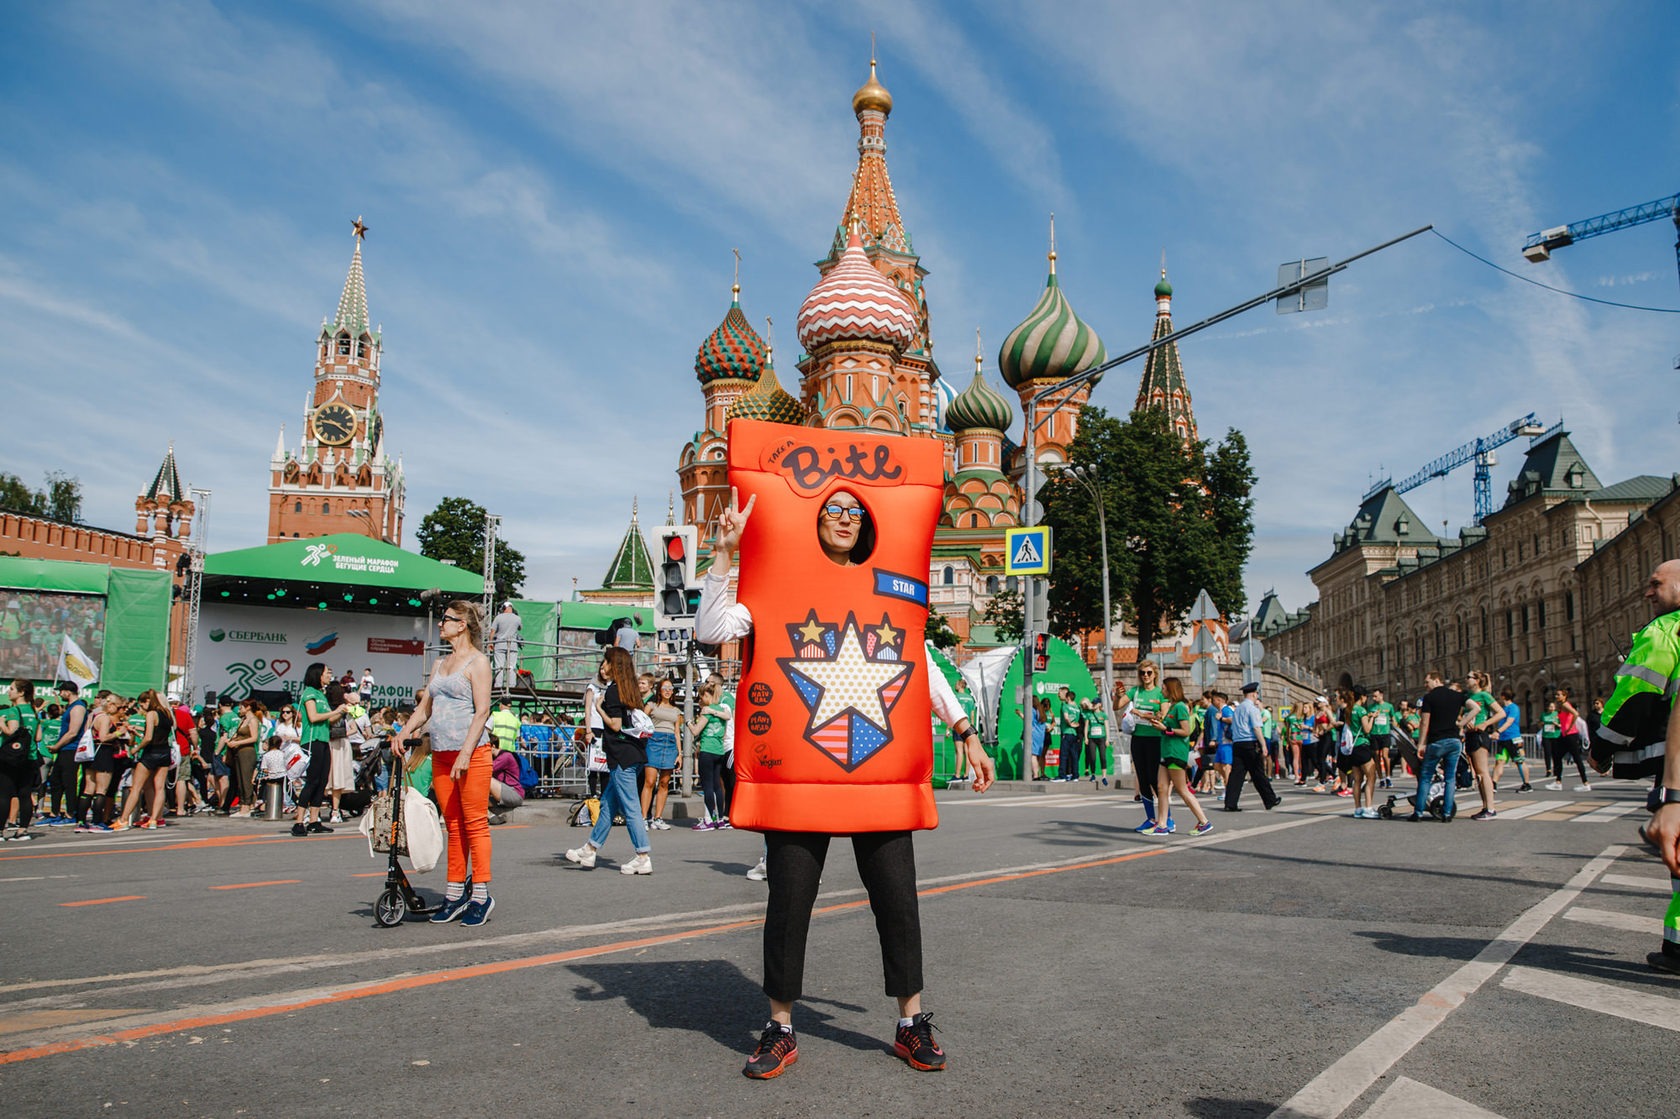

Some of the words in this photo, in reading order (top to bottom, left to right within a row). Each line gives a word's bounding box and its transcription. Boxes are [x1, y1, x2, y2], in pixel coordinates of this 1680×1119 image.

[767, 446, 786, 465] TAKE
[786, 440, 795, 448] A
[781, 444, 902, 490] Bite
[332, 554, 366, 565] ЗЕЛЕНЫЙ
[366, 557, 399, 568] МАРАФОН
[335, 562, 367, 572] БЕГУЩИЕ
[368, 564, 395, 574] СЕРДЦА
[892, 579, 915, 596] STAR
[228, 630, 287, 642] СБЕРБАНК
[352, 683, 413, 698] РАФОН
